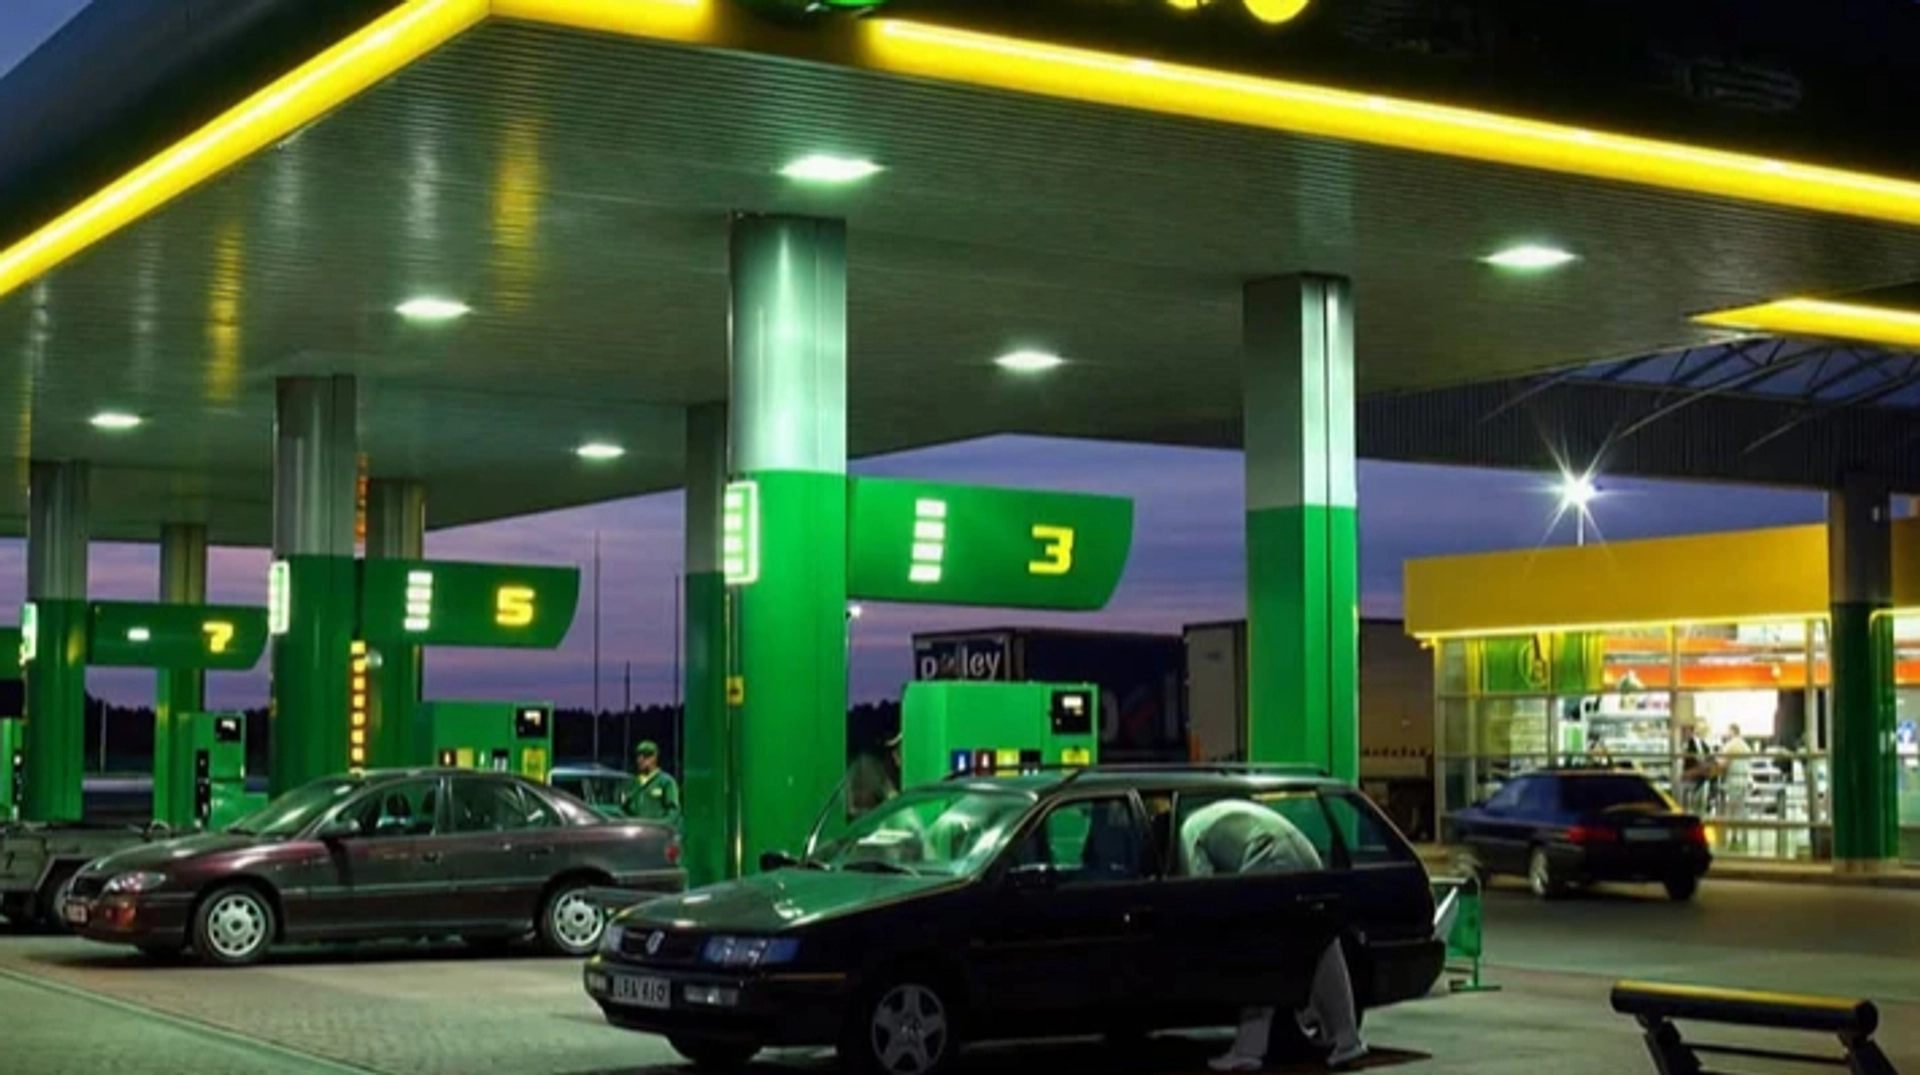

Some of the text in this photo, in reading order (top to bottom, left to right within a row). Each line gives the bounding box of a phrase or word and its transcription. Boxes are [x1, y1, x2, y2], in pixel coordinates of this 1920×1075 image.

[1028, 525, 1074, 574] 3
[497, 586, 536, 625] 5
[202, 621, 234, 652] 7
